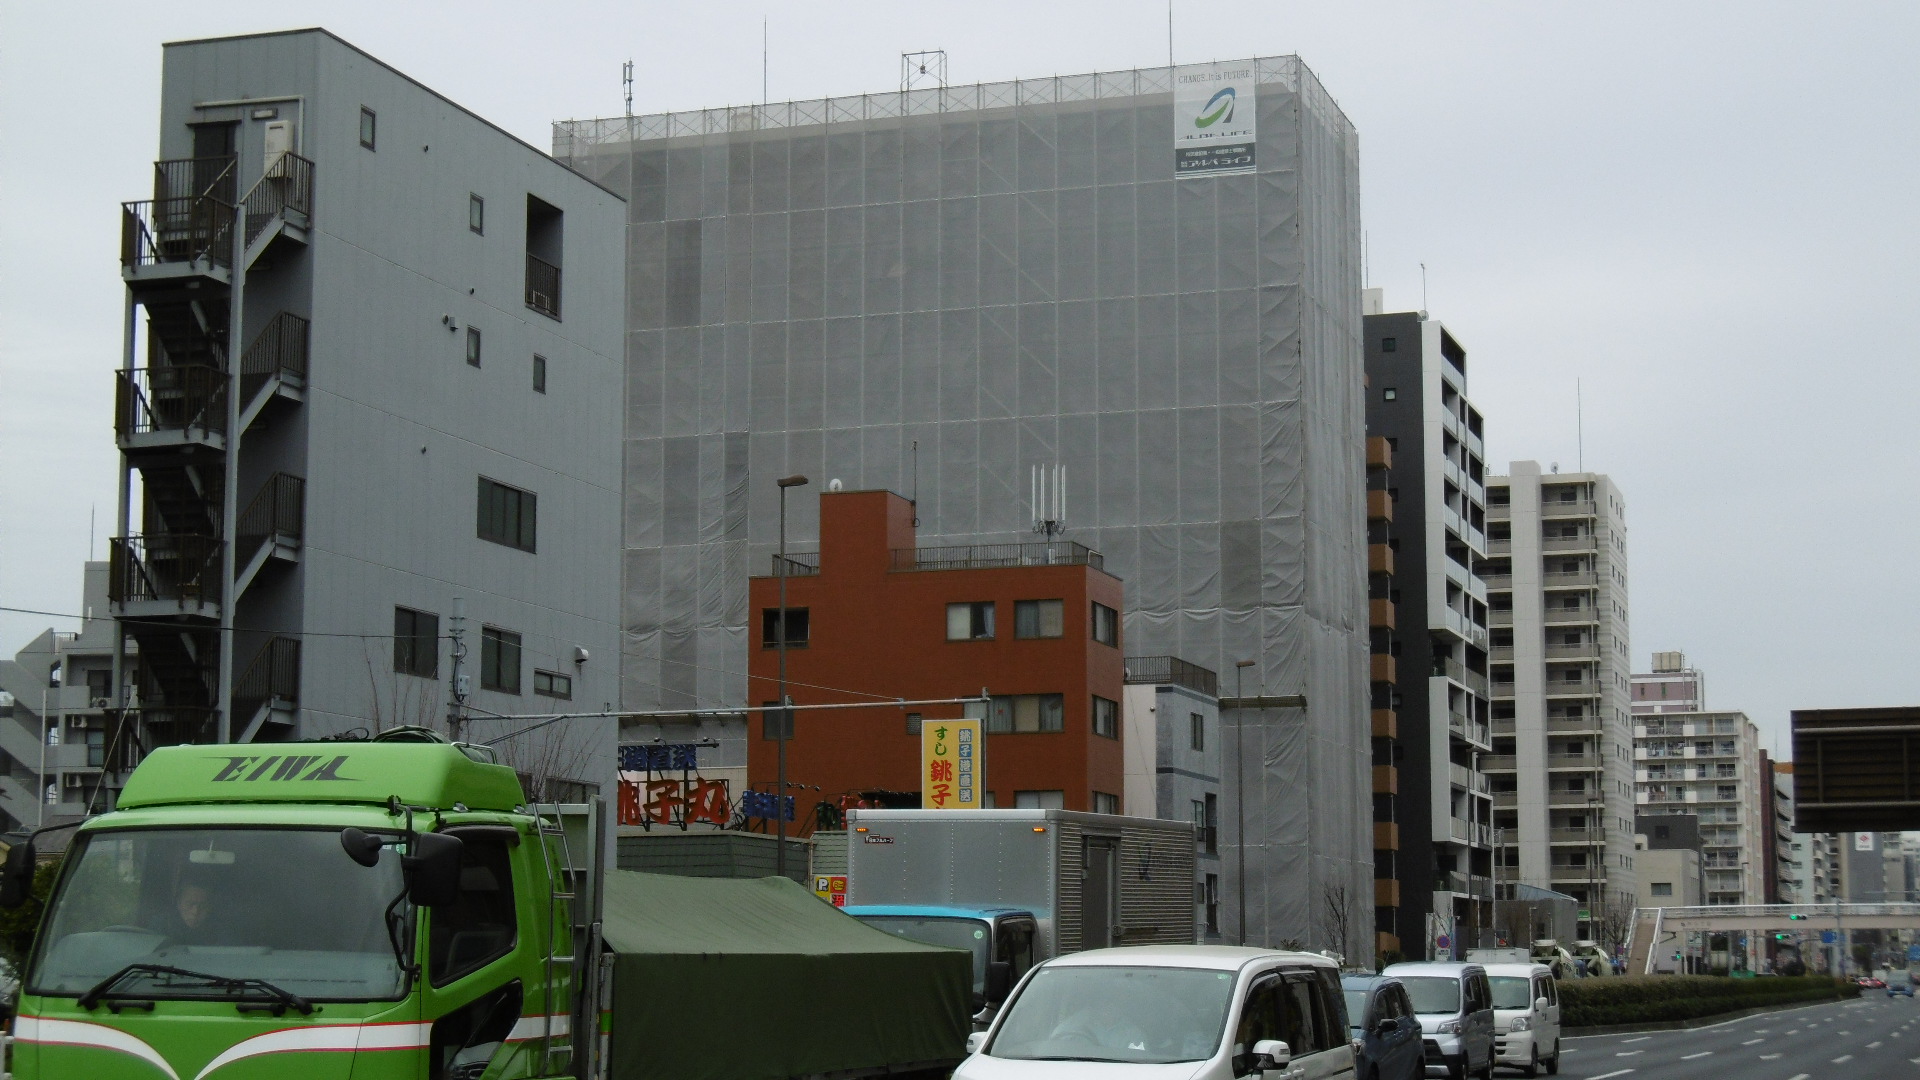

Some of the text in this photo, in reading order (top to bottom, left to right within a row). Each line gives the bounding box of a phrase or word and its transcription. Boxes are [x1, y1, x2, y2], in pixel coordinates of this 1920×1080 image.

[201, 756, 363, 782] EIWA
[930, 726, 952, 809] すし 銚子
[959, 729, 972, 802] 銚子港直送
